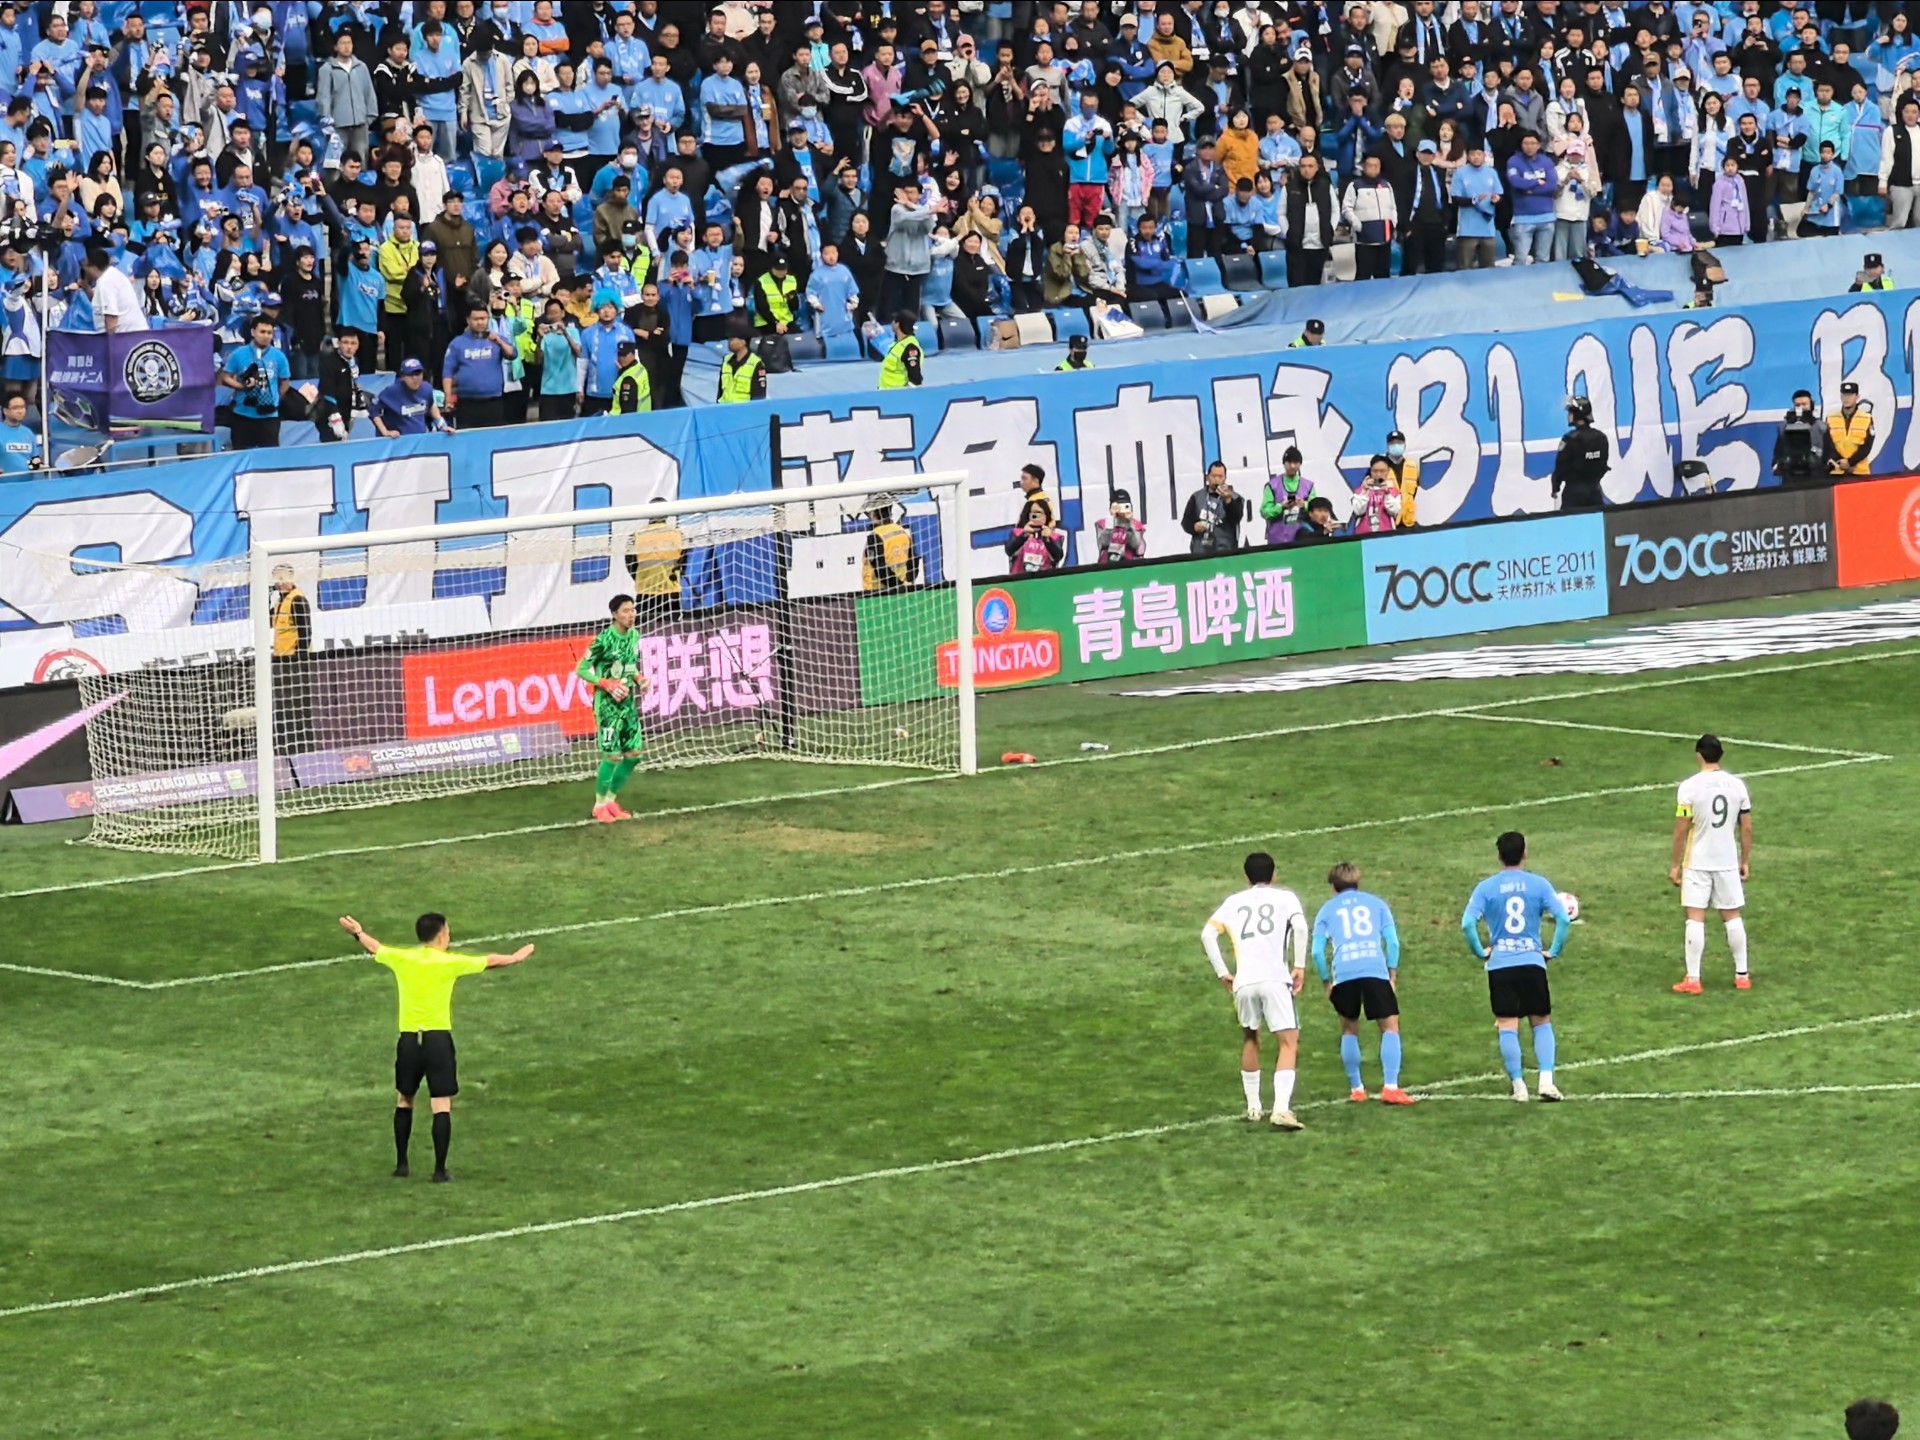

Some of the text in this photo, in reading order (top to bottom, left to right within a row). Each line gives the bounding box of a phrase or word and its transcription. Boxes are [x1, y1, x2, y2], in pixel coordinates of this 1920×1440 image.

[1386, 298, 1920, 527] BLUE B
[780, 361, 1353, 600] 蓝色血脉
[1614, 521, 1828, 587] 700CC SINCE 2011
[1731, 545, 1828, 573] 天然苏打水 鲜果茶
[1375, 550, 1596, 614] 700CC SINCE 2011
[1497, 575, 1596, 600] 天然苏打水 鲜果茶
[1072, 566, 1295, 664] 青岛啤酒
[638, 624, 776, 718] 联想
[944, 639, 1053, 677] TINGTAO
[1711, 794, 1729, 829] 9
[1237, 903, 1275, 940] 28
[1336, 905, 1374, 940] 18
[1504, 895, 1526, 935] 8
